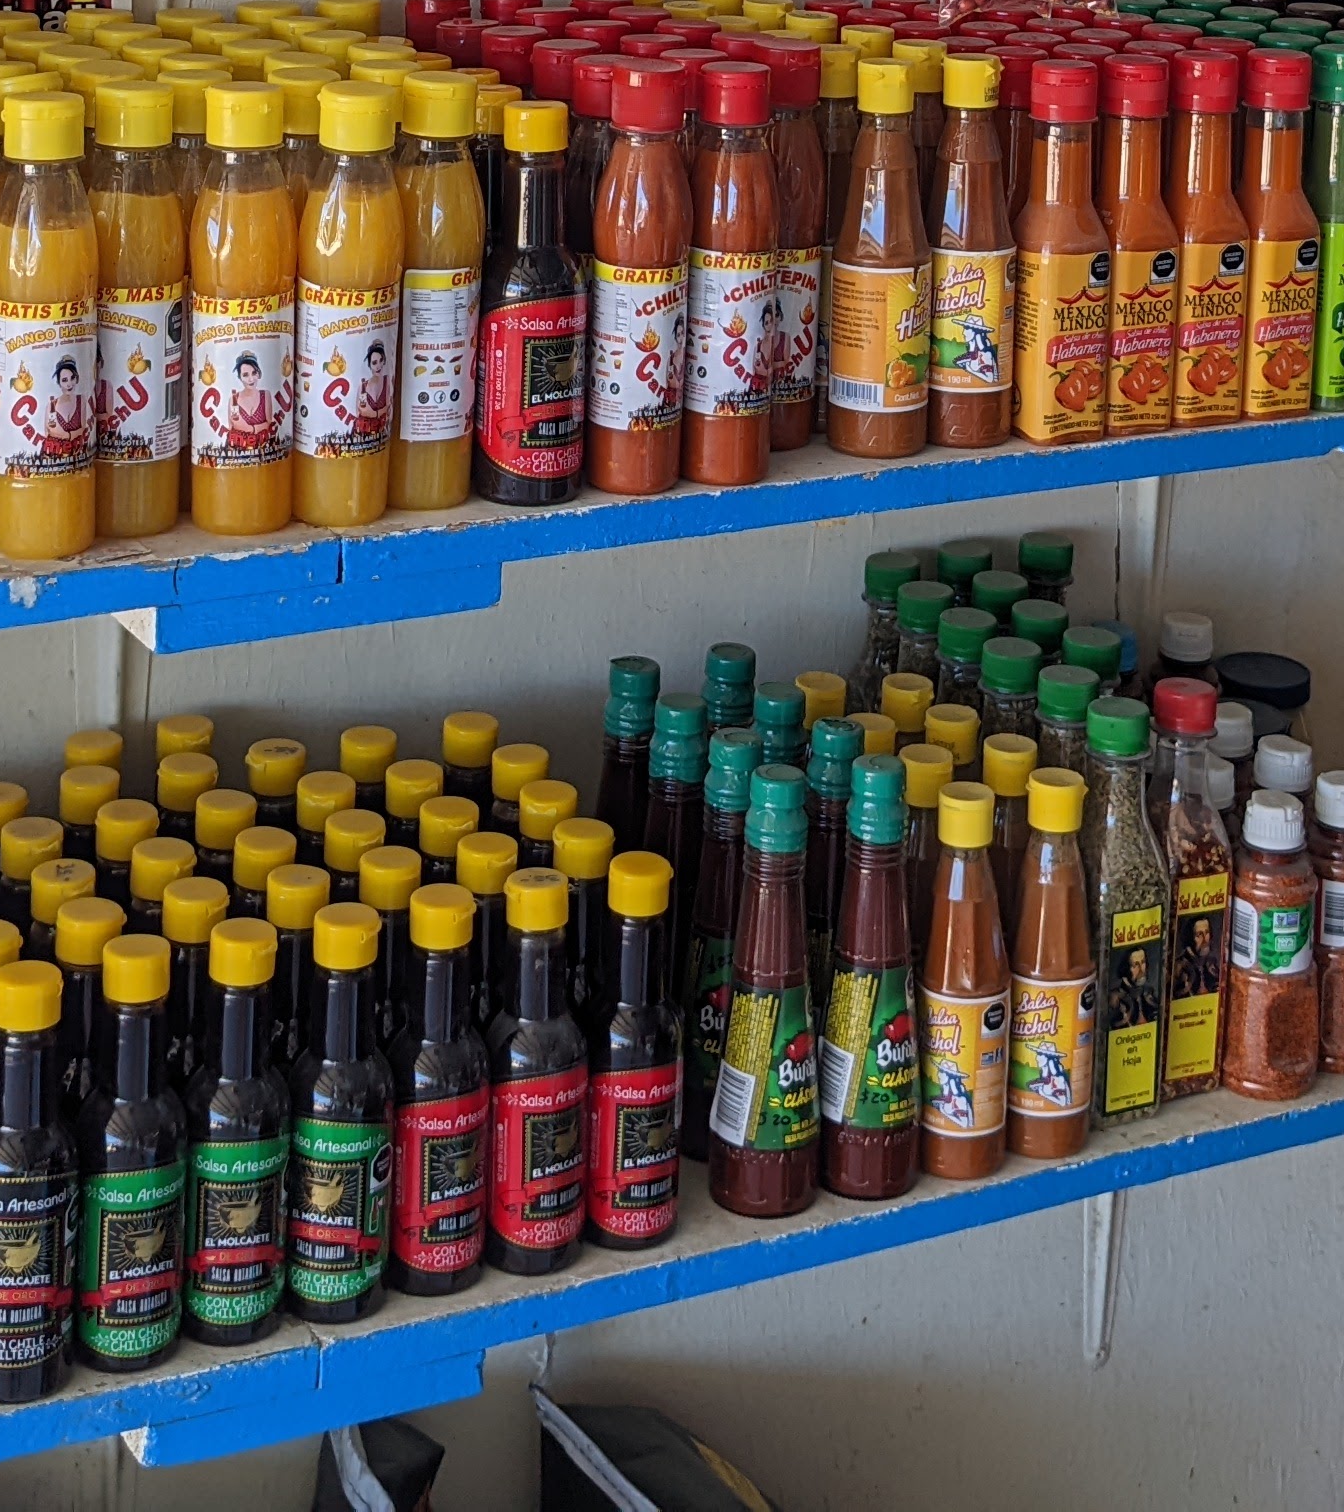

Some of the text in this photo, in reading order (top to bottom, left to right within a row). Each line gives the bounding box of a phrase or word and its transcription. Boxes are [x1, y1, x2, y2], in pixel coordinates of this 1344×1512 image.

[703, 253, 762, 268] GRATIS
[613, 269, 674, 284] GRATIS
[940, 264, 983, 289] Salsa
[305, 289, 366, 307] GRATIS
[1184, 291, 1242, 308] MÉXICO
[1115, 298, 1173, 316] MÉXICO
[520, 319, 553, 331] Salsa
[6, 328, 56, 353] MANGO
[1182, 328, 1241, 347] Habanero
[1113, 337, 1172, 356] Habanero
[1179, 885, 1224, 910] Sal de Cortés
[1115, 1030, 1152, 1046] Orégano
[1127, 1045, 1138, 1054] en
[1122, 1056, 1142, 1067] Hoja
[313, 1140, 373, 1154] Artesanal
[7, 1191, 67, 1212] Artesanal
[301, 1213, 354, 1226] MOLCAJETE
[12, 1337, 45, 1348] CHILE
